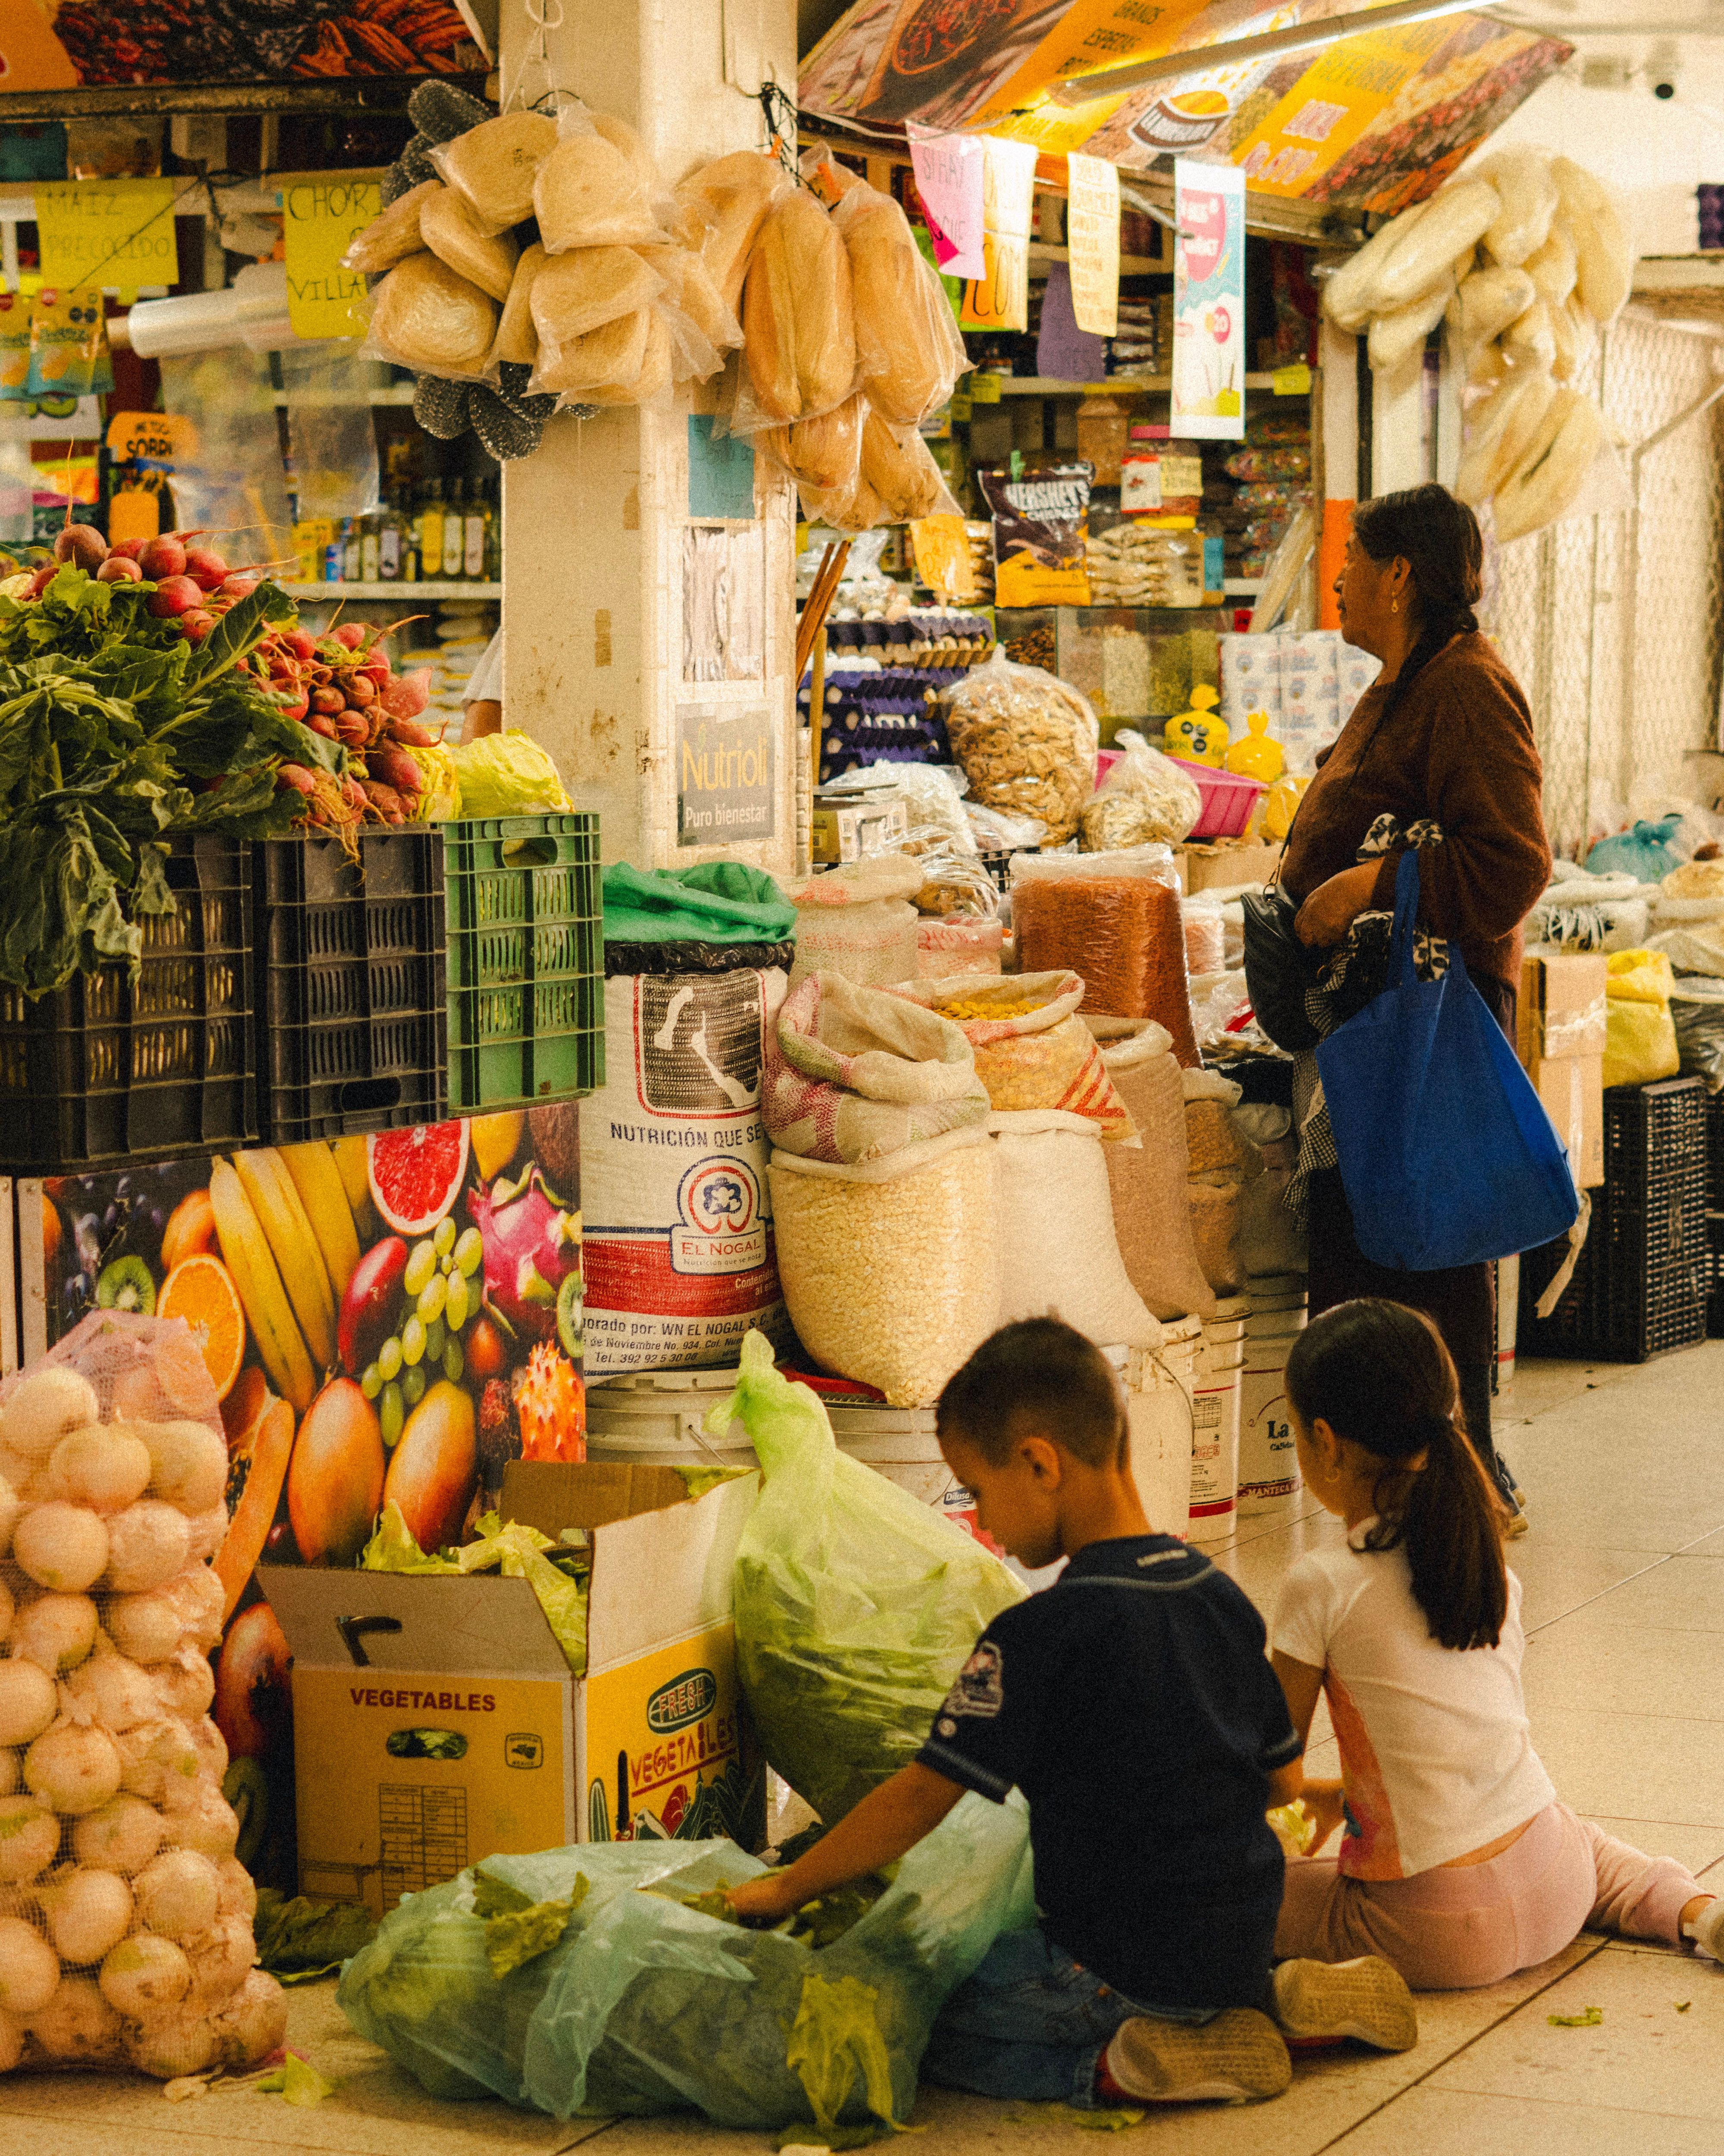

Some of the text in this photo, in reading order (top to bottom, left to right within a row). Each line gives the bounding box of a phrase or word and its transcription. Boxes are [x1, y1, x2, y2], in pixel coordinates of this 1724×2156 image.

[47, 191, 123, 216] MAIZ
[289, 181, 383, 221] CHORI
[683, 735, 767, 791] Nutrioli
[685, 803, 767, 828] Puro bienestar
[610, 1122, 762, 1148] NUTRICIÓN QUE SE
[681, 1239, 760, 1255] EL NOGAL
[748, 1252, 762, 1261] nota
[631, 1323, 656, 1336] por:
[662, 1323, 684, 1336] WN
[687, 1324, 702, 1336] EL
[706, 1320, 745, 1335] NOGAL
[590, 1336, 603, 1347] de
[606, 1337, 661, 1350] Noviembre
[664, 1341, 679, 1350] No.
[705, 1339, 721, 1348] Col.
[724, 1337, 743, 1346] Nue
[595, 1352, 615, 1363] Tel.
[620, 1354, 641, 1364] 392
[644, 1354, 658, 1363] 92
[1267, 1420, 1289, 1439] La
[1248, 1483, 1291, 1496] MANTECA
[350, 1688, 496, 1712] VEGETABLES
[659, 1677, 706, 1724] FRESH
